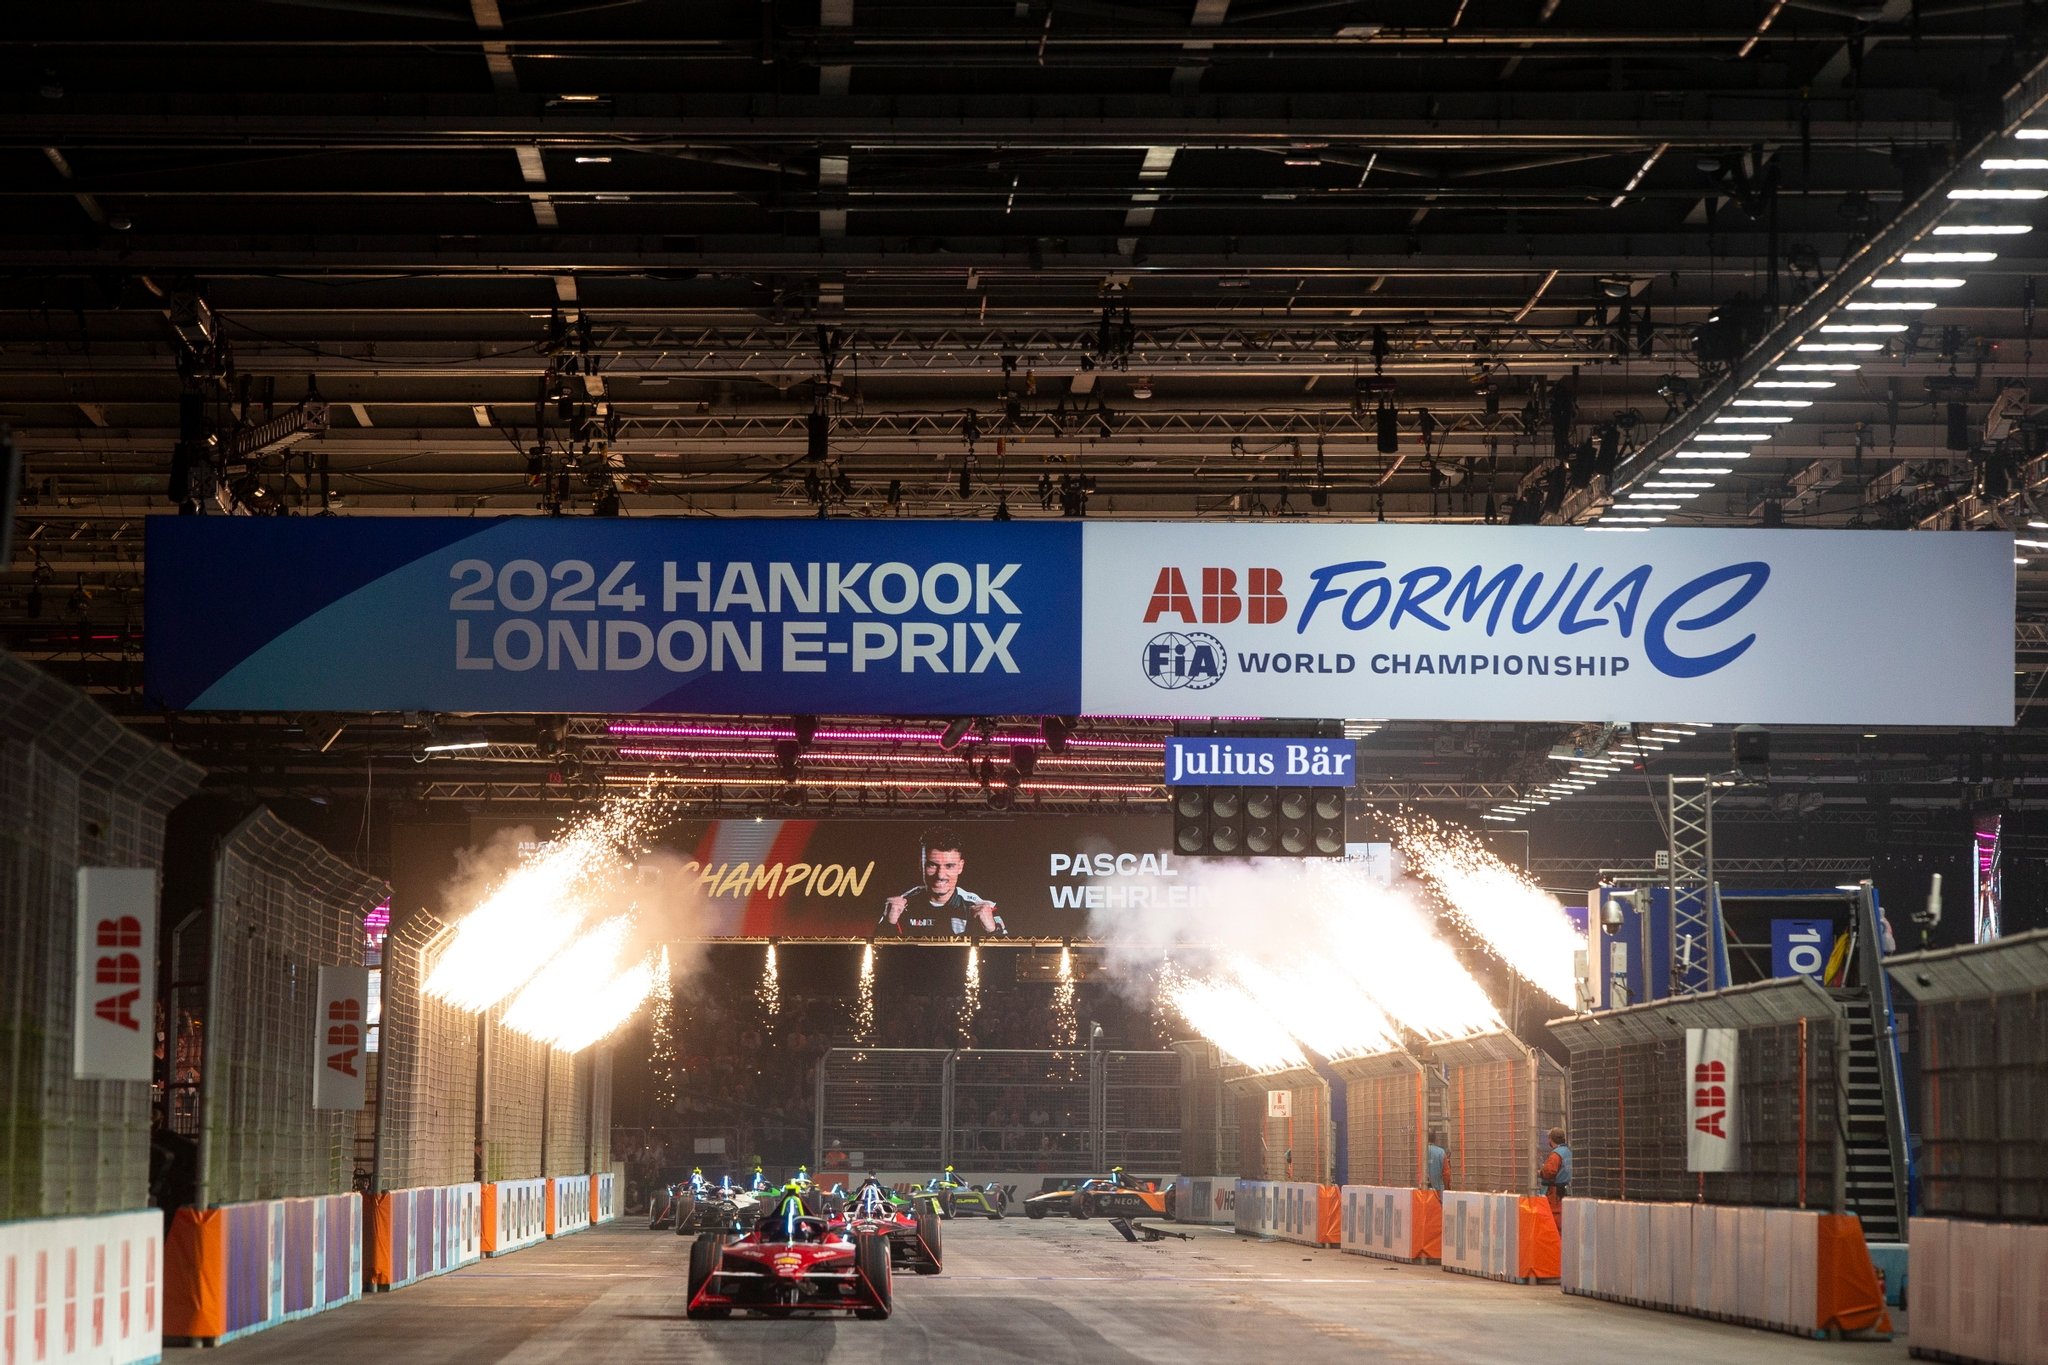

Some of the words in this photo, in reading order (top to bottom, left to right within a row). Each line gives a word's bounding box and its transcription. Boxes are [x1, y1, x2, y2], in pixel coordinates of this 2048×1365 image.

[449, 559, 644, 613] 2024
[663, 561, 1022, 615] HANKOOK
[1143, 567, 1287, 625] ABB
[1297, 560, 1653, 638] FORMULA
[455, 617, 763, 674] LONDON
[782, 622, 1020, 675] E-PRIX
[1238, 653, 1356, 674] WORLD
[1370, 654, 1630, 678] CHAMPIONSHIP
[1173, 744, 1275, 781] Julius
[1285, 745, 1351, 776] Bär
[679, 861, 875, 900] CHAMPION
[1050, 853, 1178, 877] PASCAL
[95, 915, 141, 1032] ABB
[327, 998, 361, 1078] ABB
[1695, 1060, 1726, 1139] ABB
[1114, 1197, 1140, 1205] NEOM
